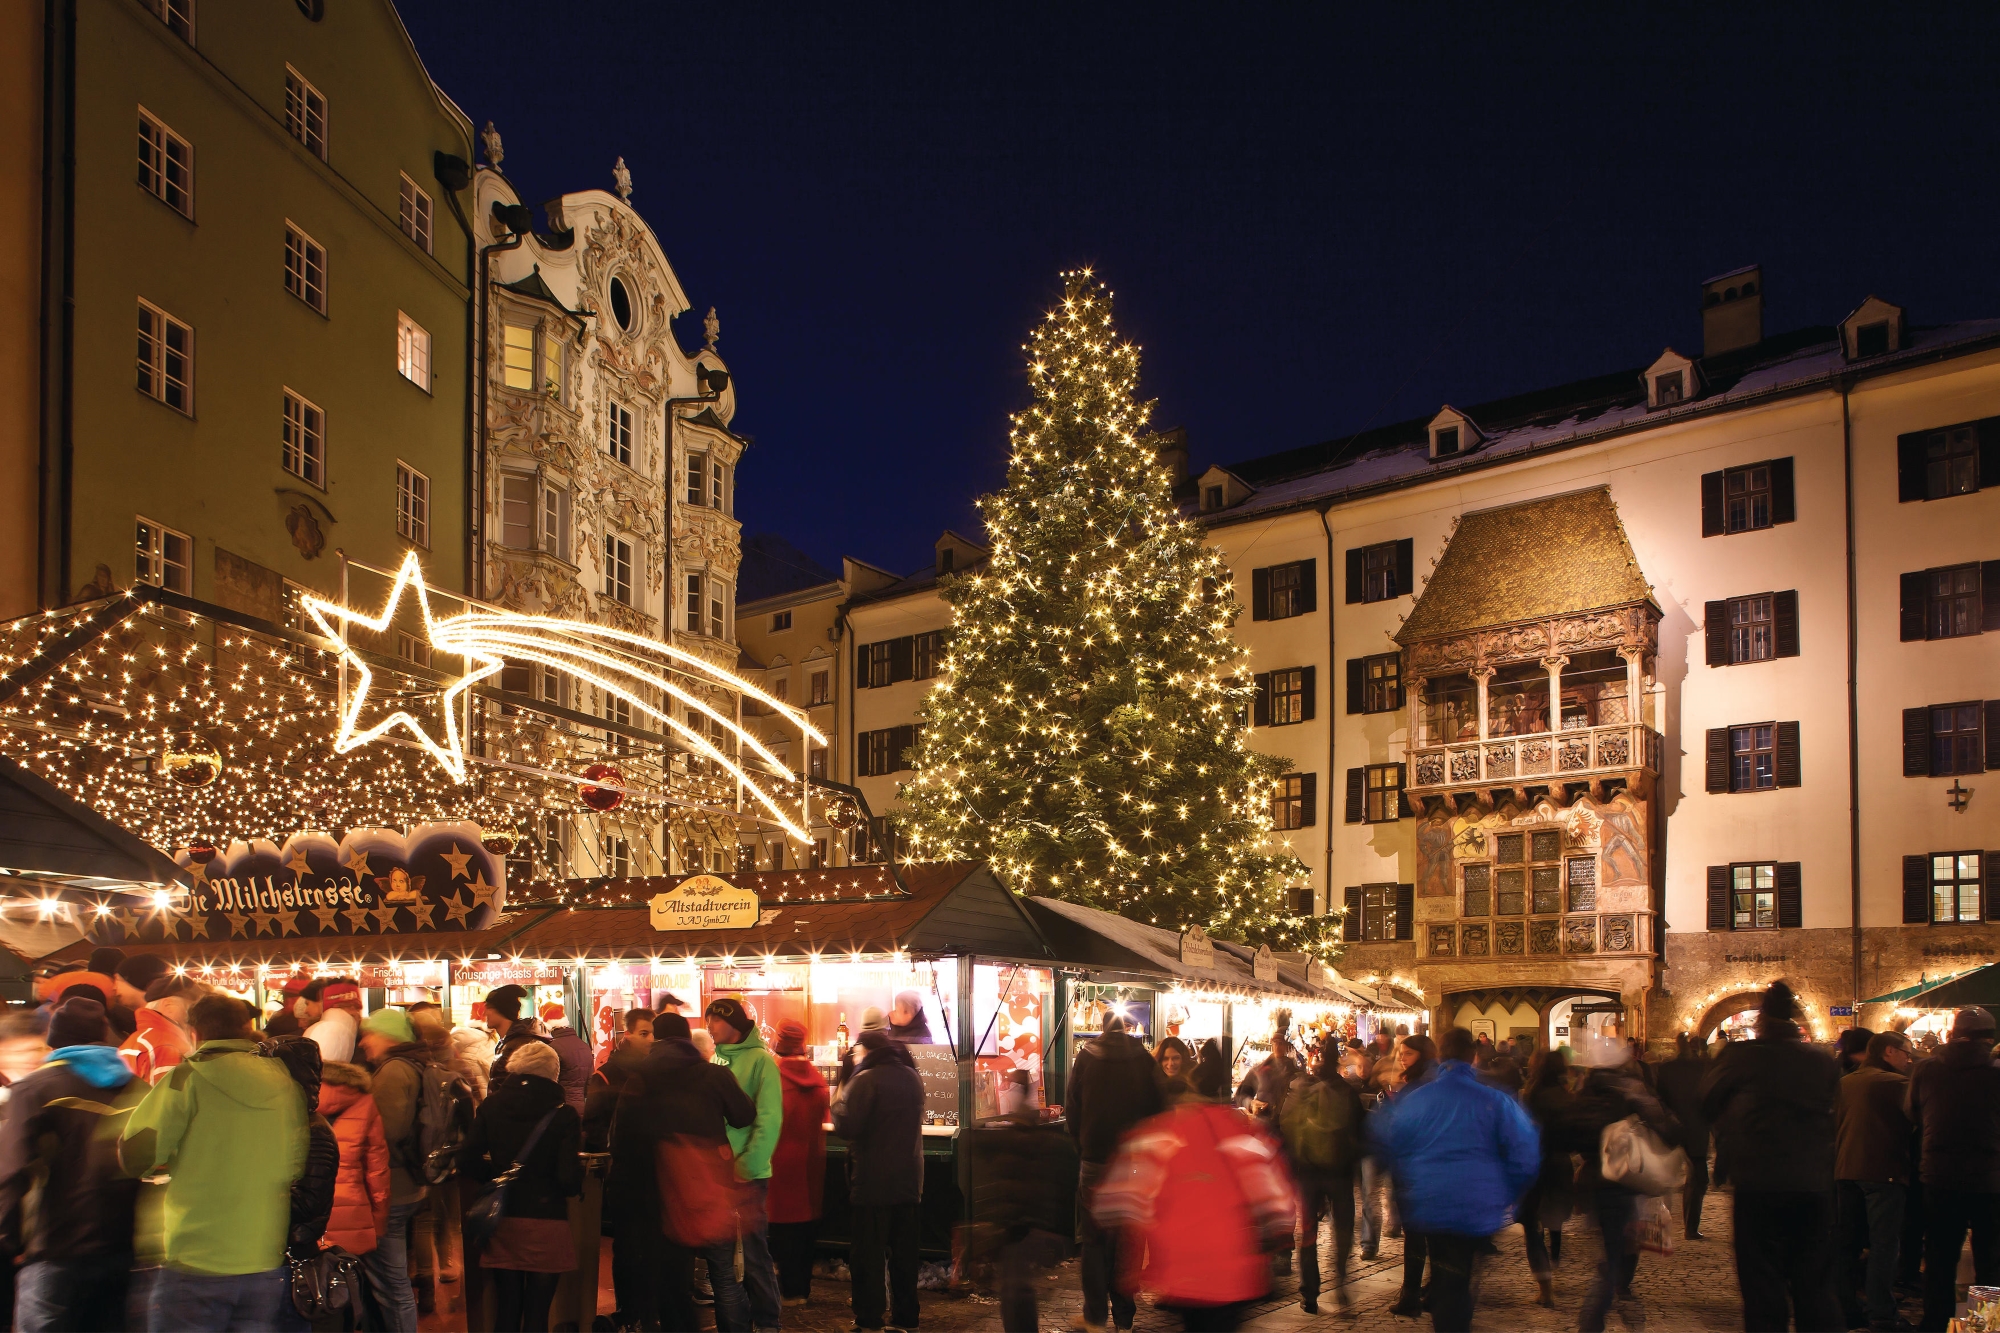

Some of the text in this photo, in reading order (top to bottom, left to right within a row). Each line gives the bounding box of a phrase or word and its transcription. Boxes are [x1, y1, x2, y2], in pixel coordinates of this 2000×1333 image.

[175, 888, 209, 912] Die
[657, 899, 751, 914] Altstadtverein
[702, 915, 731, 927] GmbH
[454, 969, 501, 983] Knusprige
[502, 967, 532, 980] Toasts
[639, 974, 691, 989] SCHOKOLADE
